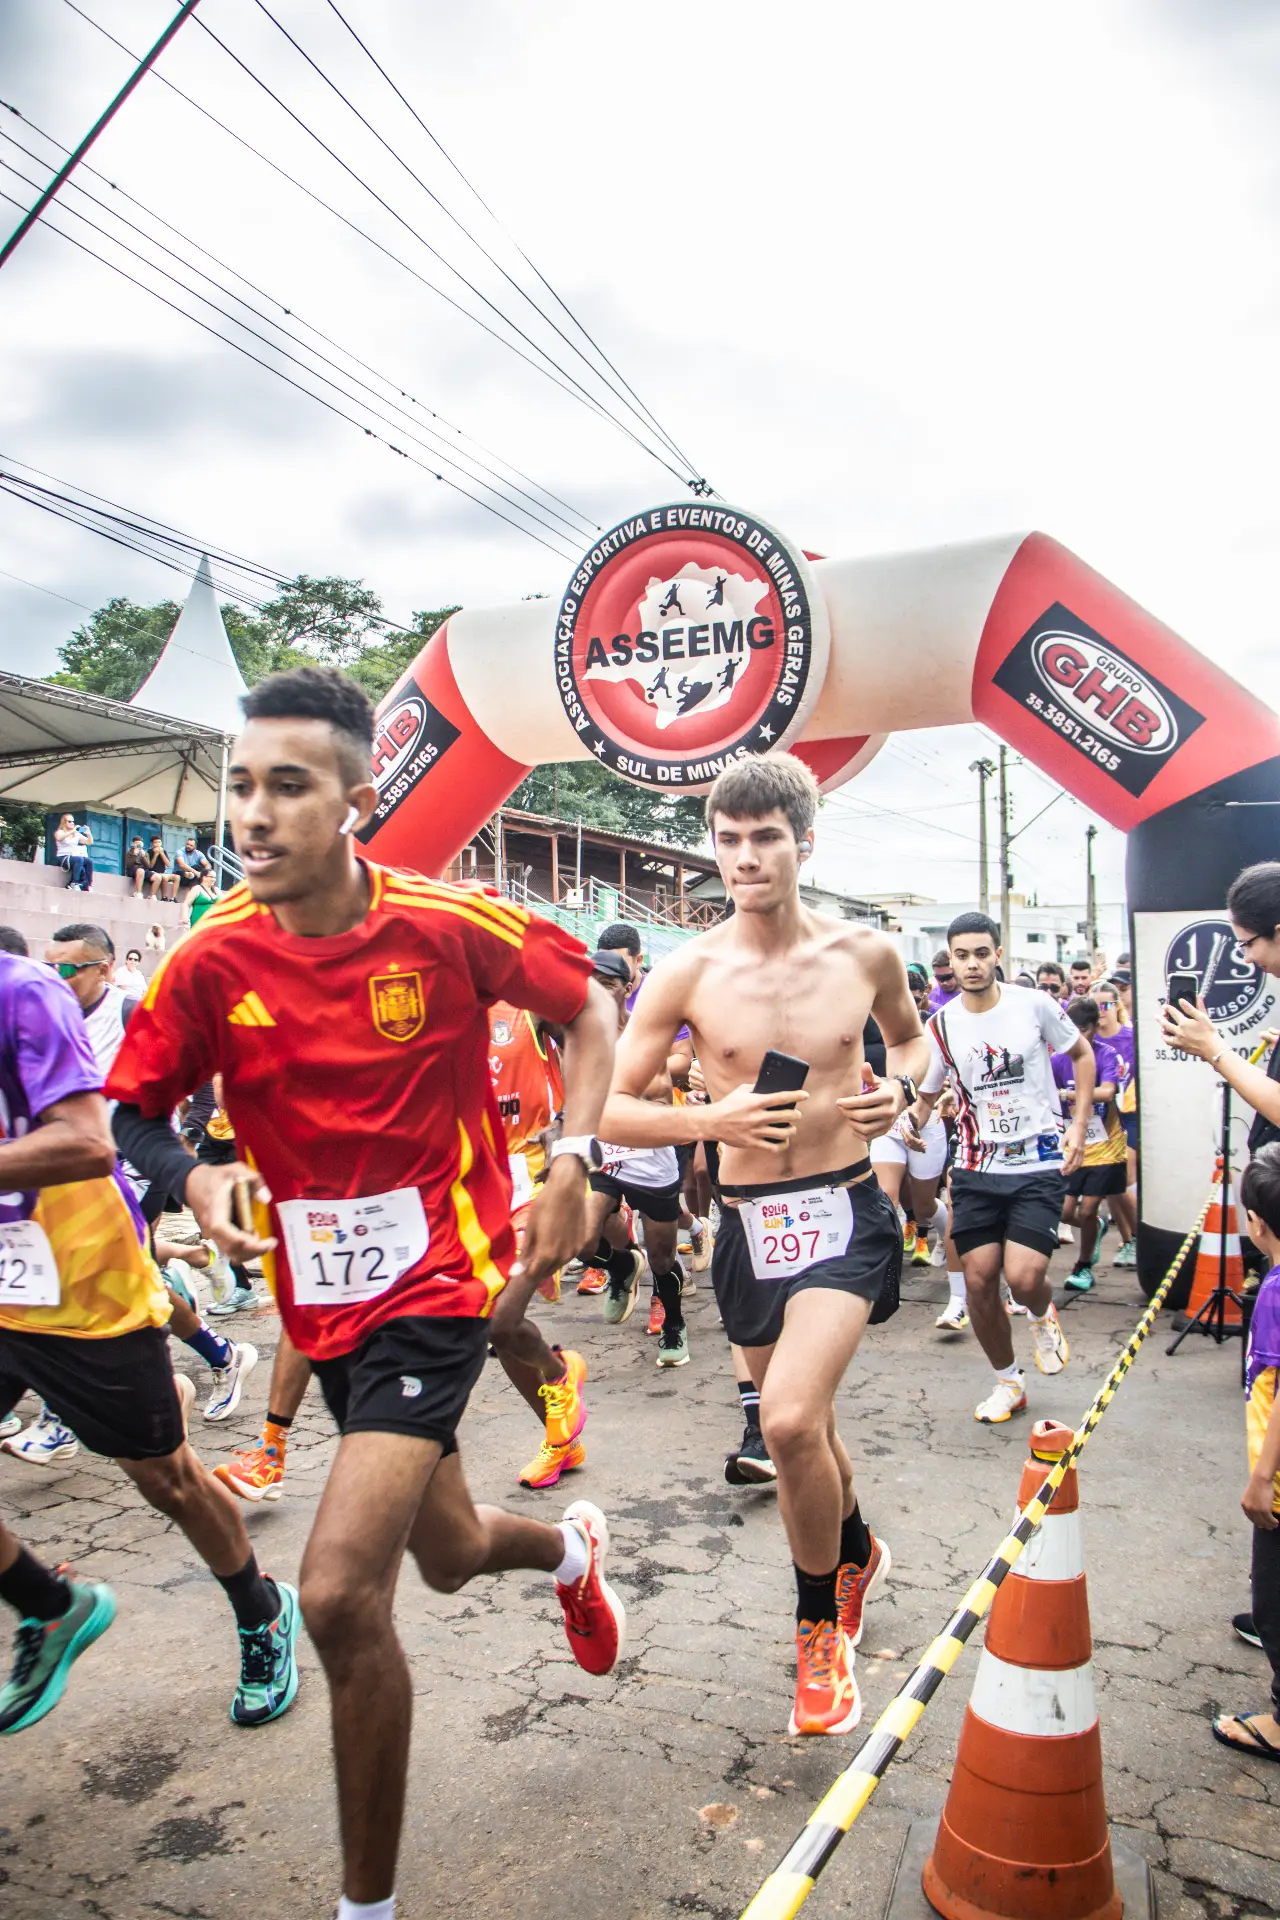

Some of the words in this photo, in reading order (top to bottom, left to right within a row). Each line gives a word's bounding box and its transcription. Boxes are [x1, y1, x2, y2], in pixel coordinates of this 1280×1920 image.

[650, 512, 662, 530] E
[667, 508, 748, 538] EVENTOS
[570, 518, 648, 597] ESPORTIVA
[746, 529, 773, 557] DE
[765, 553, 802, 619] MINAS
[585, 616, 775, 669] ASSEEMG
[557, 598, 590, 732] ASSOCIAÇÃO
[776, 625, 804, 707] GERAIS
[1096, 655, 1143, 694] GRUPO
[1041, 643, 1162, 747] GHB
[369, 709, 420, 777] HB
[1025, 692, 1122, 771] 35.3851.2165
[374, 743, 439, 819] 35.3851.2165
[616, 755, 652, 780] SUL
[656, 765, 683, 782] DE
[686, 745, 747, 781] MINAS
[1207, 985, 1256, 1018] FUSOS
[1228, 994, 1276, 1037] VAREJO
[992, 1089, 1010, 1097] TEAM
[989, 1116, 1020, 1134] 167
[311, 1246, 389, 1286] 172
[763, 1230, 820, 1264] 297
